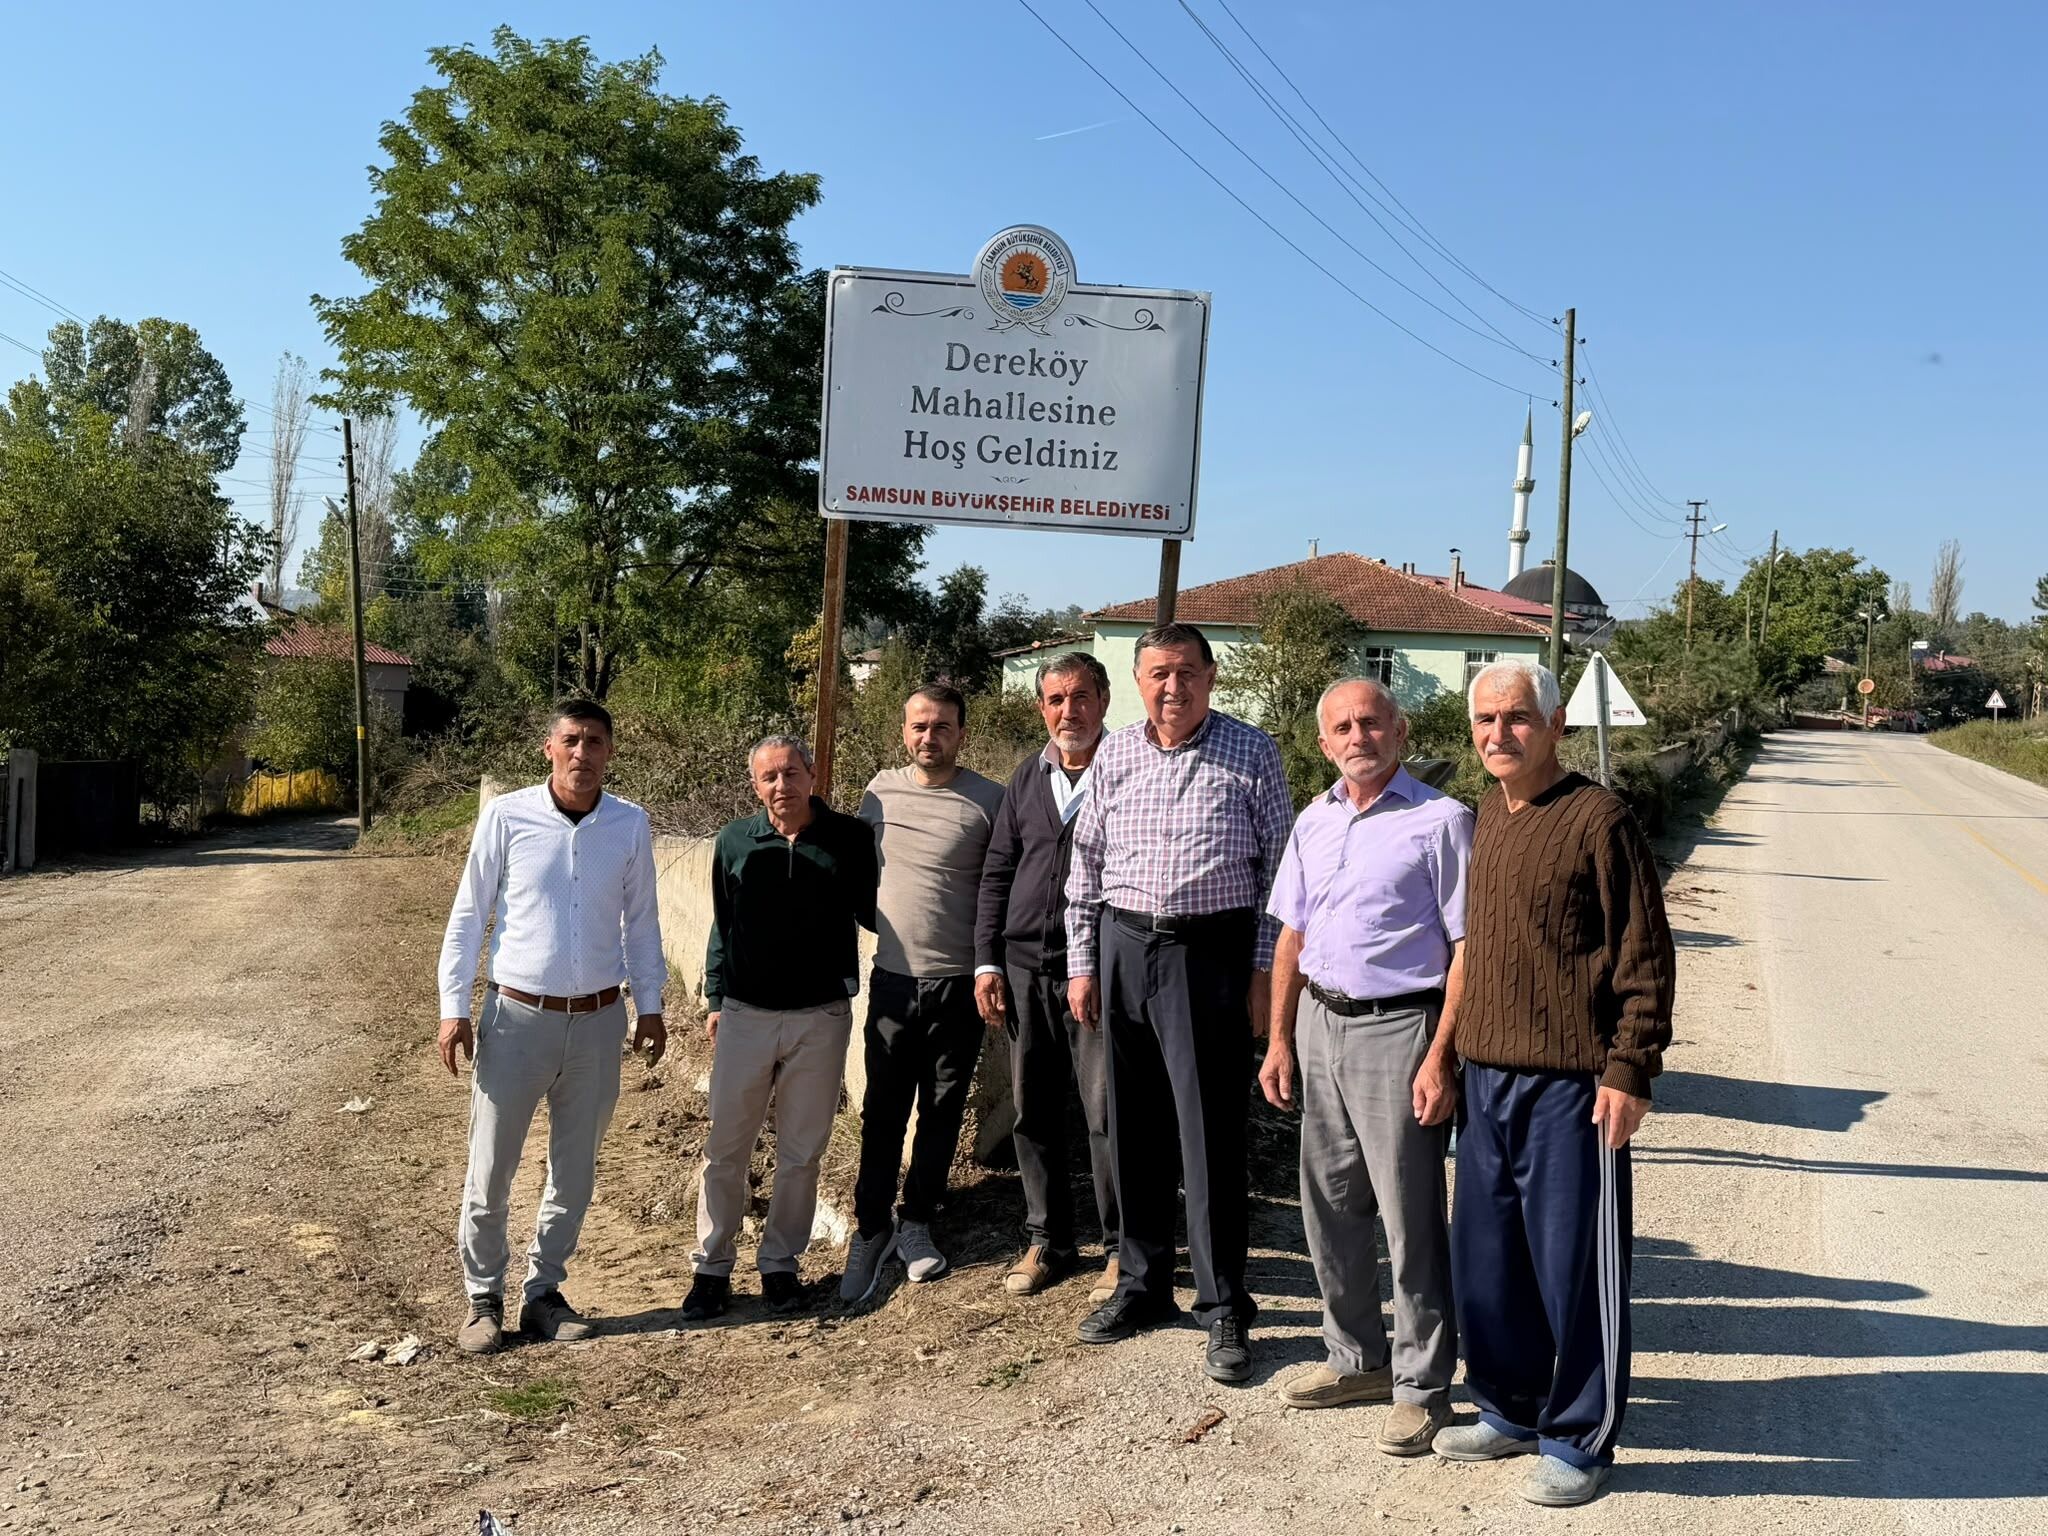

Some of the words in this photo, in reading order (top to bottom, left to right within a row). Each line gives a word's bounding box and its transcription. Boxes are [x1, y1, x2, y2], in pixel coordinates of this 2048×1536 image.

[986, 241, 1008, 264] SAMSUN
[944, 342, 1089, 387] Dereköy
[909, 385, 1116, 427] Mahallesine
[903, 430, 966, 470] Hoş
[976, 434, 1119, 471] Geldiniz
[846, 485, 926, 505] SAMSUN
[931, 491, 1055, 513] BÜYÜKŞEHİR
[1060, 498, 1170, 521] BELEDİYESİ
